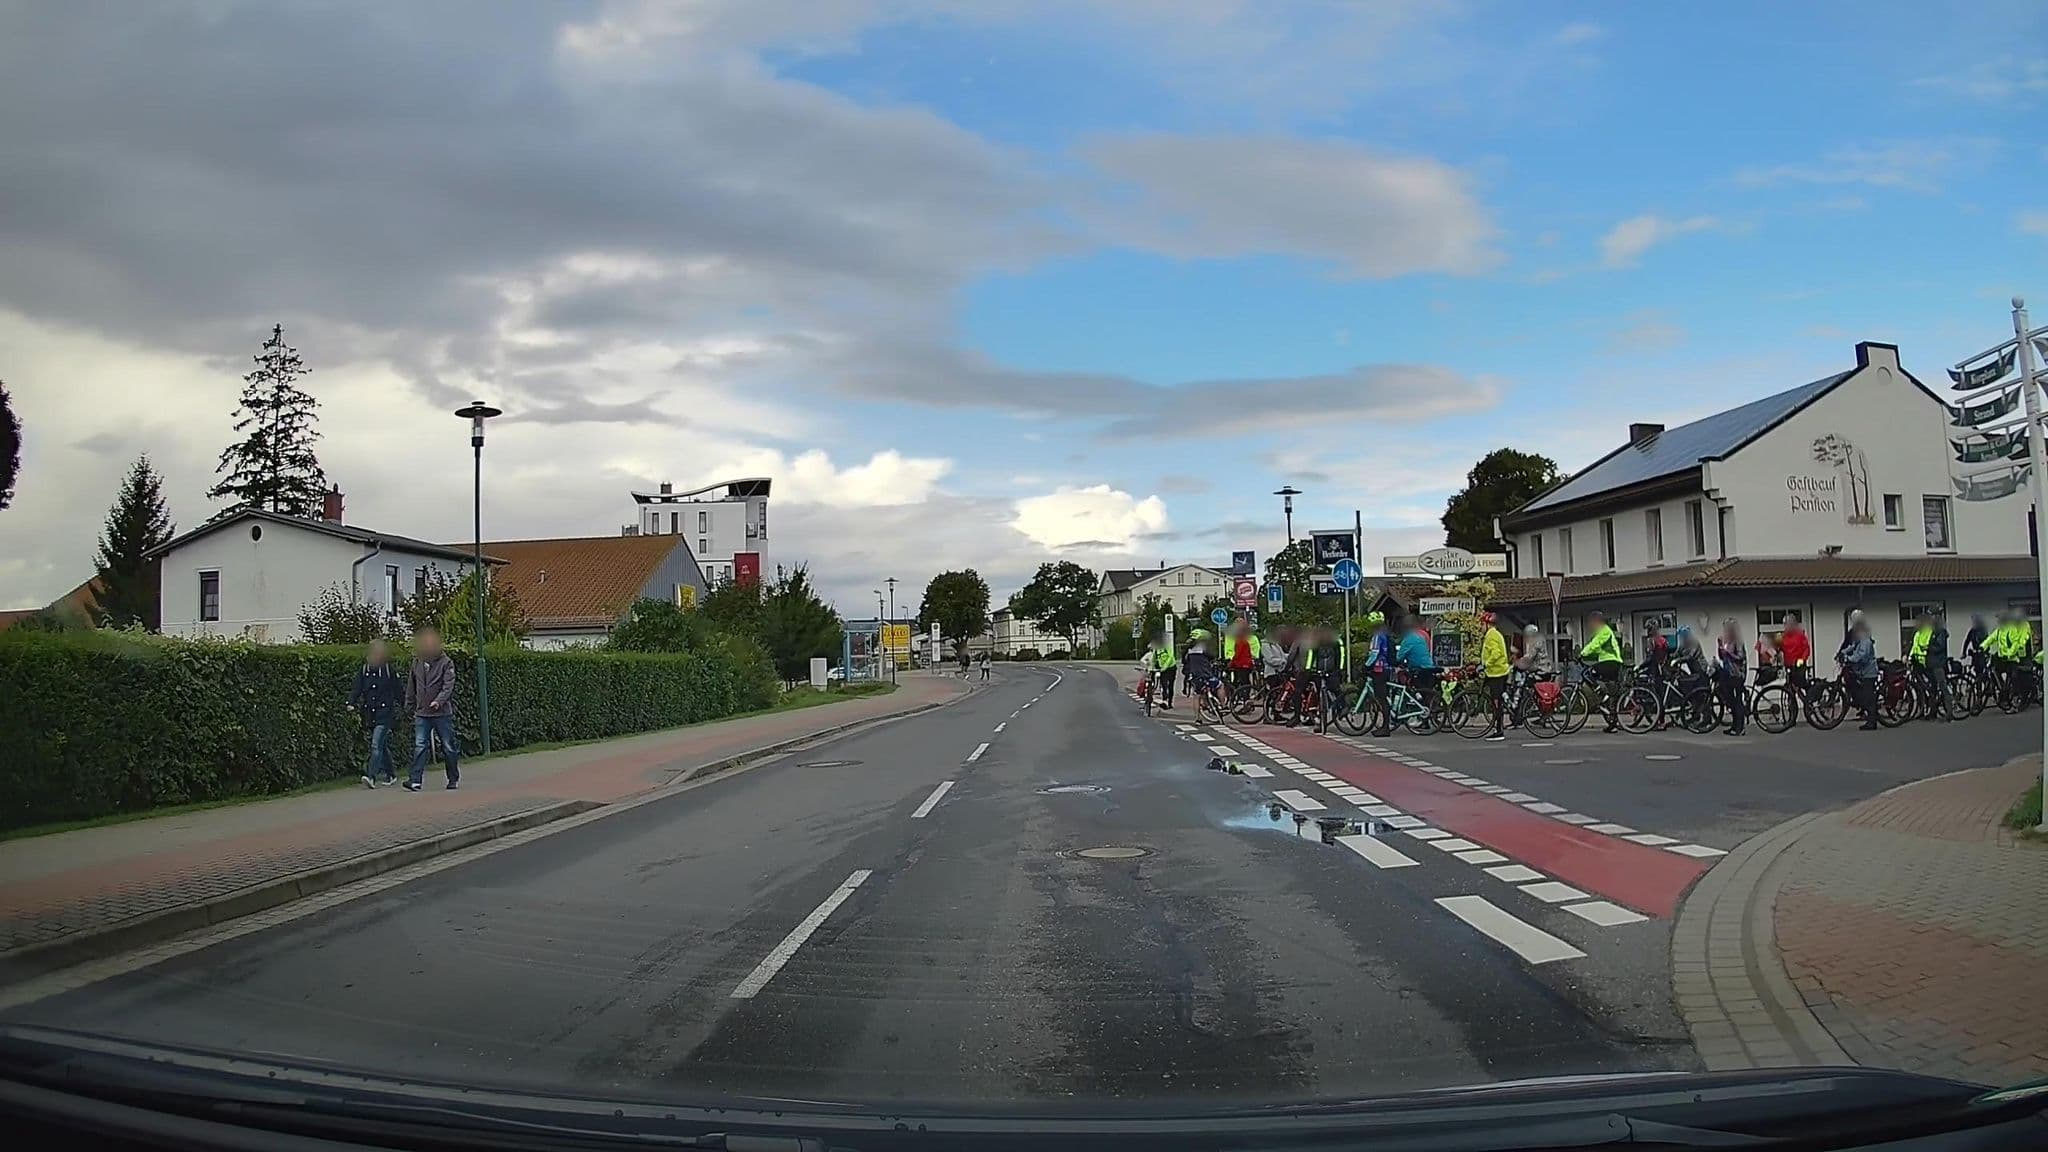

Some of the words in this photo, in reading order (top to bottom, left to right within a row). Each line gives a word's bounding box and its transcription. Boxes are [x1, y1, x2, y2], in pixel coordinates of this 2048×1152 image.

[1387, 560, 1418, 570] GASTHAUS
[1421, 600, 1456, 612] Zimmer
[1457, 600, 1474, 610] frei
